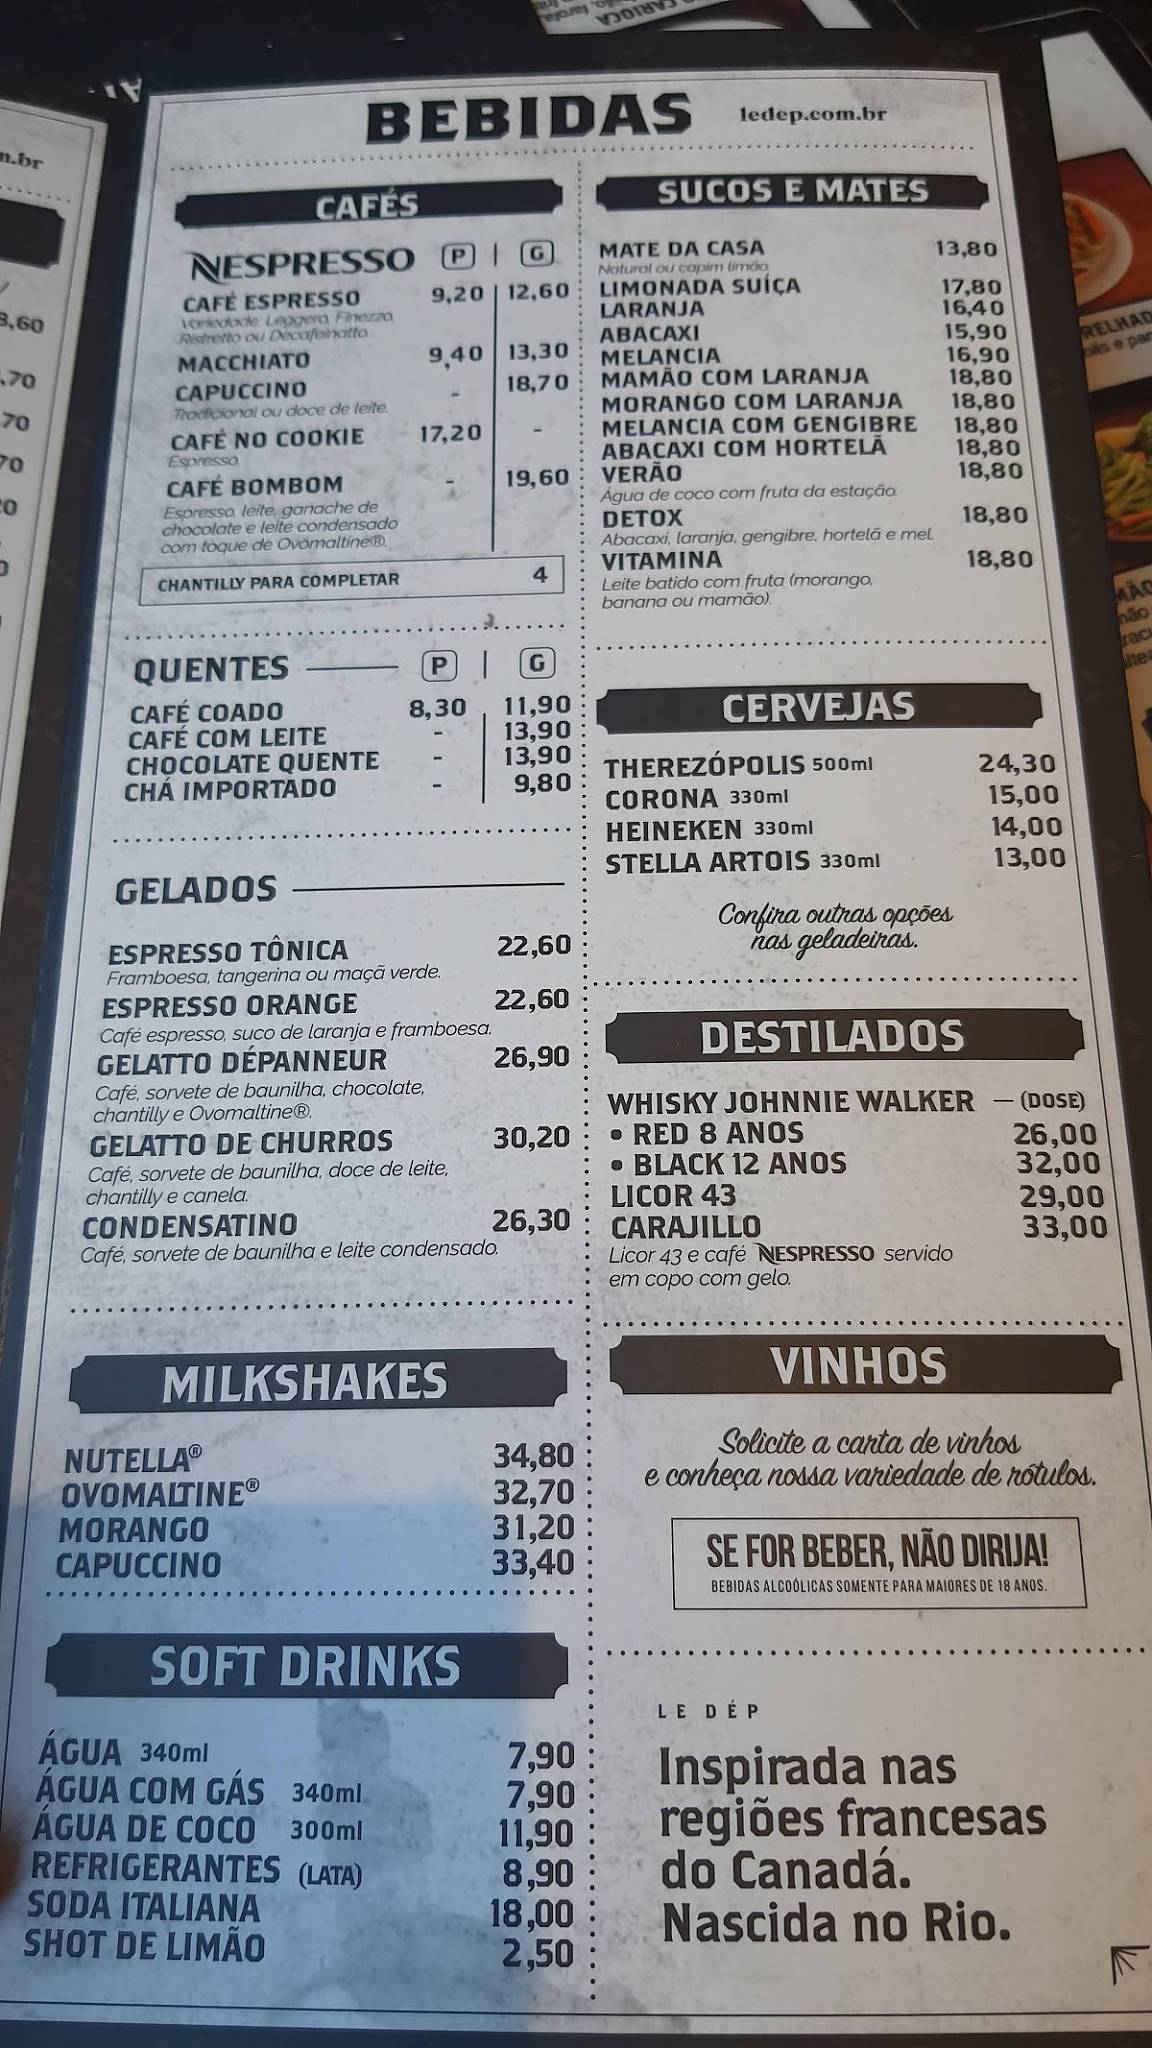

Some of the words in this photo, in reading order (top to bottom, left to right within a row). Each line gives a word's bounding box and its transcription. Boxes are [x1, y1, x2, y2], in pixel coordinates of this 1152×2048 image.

[366, 92, 692, 145] BEBIDAS
[740, 106, 887, 125] ledep.com.br
[317, 188, 418, 220] CAFÉS
[659, 179, 772, 204] SUCOS
[785, 179, 804, 201] E
[816, 179, 928, 202] MATES
[600, 242, 659, 258] MATE
[669, 242, 699, 256] DA
[708, 240, 764, 255] CASA
[937, 241, 997, 258] 13,80
[190, 248, 415, 285] NESPRESSO
[432, 286, 483, 304] 9,20
[509, 283, 569, 301] 12,60
[601, 279, 724, 297] LIMONADA
[733, 274, 800, 296] SUÍÇA
[943, 279, 1001, 296] 17,80
[184, 292, 236, 313] CAFÉ
[245, 290, 360, 310] ESPRESSO
[601, 301, 704, 318] LARANJA
[943, 299, 1004, 317] 16,40
[600, 325, 698, 343] ABACAXI
[946, 323, 1006, 342] 15,90
[178, 352, 310, 373] MACCHIATO
[429, 346, 482, 370] 9,40
[510, 343, 568, 361] 13,30
[602, 348, 720, 366] MELANCIA
[948, 347, 1009, 365] 16,90
[176, 381, 306, 402] CAPUCCINO
[508, 374, 568, 393] 18,70
[603, 418, 724, 437] MELANCIA
[733, 417, 783, 433] COM
[794, 416, 917, 432] GENGIBRE
[955, 417, 1017, 436] 18,80
[167, 475, 223, 498] CAFÉ
[232, 476, 342, 496] BOMBOM
[507, 469, 568, 489] 19,60
[603, 509, 682, 528] DETOX
[964, 506, 1028, 526] 18,80
[823, 528, 881, 541] hortelã
[886, 531, 896, 540] e
[158, 578, 245, 592] CHANTILLY
[251, 576, 294, 589] PARA
[300, 573, 399, 587] COMPLETAR
[533, 566, 548, 583] 4
[135, 656, 288, 686] QUENTES
[131, 699, 190, 724] CAFÉ
[198, 703, 283, 722] COADO
[410, 698, 466, 720] 8,30
[505, 695, 570, 717] 11,90
[723, 692, 914, 722] CERVEJAS
[604, 750, 805, 779] THEREZÓPOLIS
[813, 757, 872, 771] 500ml
[979, 754, 1055, 776] 24,30
[125, 777, 174, 802] CHÁ
[184, 778, 336, 801] IMPORTADO
[515, 773, 571, 796] 9,80
[989, 785, 1059, 807] 15,00
[606, 788, 718, 810] CORONA
[731, 789, 788, 804] 330ml
[116, 875, 276, 905] GELADOS
[719, 902, 801, 934] Confira
[806, 903, 877, 923] outras
[883, 905, 953, 929] opções
[109, 943, 241, 965] ESPRESSO
[251, 935, 348, 962] TÔNICA
[498, 935, 571, 959] 22,60
[751, 934, 792, 950] nas
[796, 926, 917, 960] geladeiras.
[107, 970, 209, 985] Framboesa,
[217, 967, 301, 986] tangerina
[306, 970, 328, 981] ou
[334, 965, 385, 983] maçã
[391, 964, 440, 979] verde.
[702, 1020, 964, 1054] DESTILADOS
[97, 1053, 211, 1076] GELATTO
[222, 1045, 386, 1073] DÉPANNEUR
[495, 1046, 569, 1071] 26,90
[607, 1092, 718, 1115] WHISKY
[724, 1091, 850, 1113] JOHNNIE
[856, 1090, 975, 1112] WALKER
[1021, 1091, 1085, 1112] (DOSE)
[612, 1184, 693, 1207] LICOR
[701, 1184, 736, 1206] 43
[1020, 1185, 1104, 1211] 29,00
[82, 1213, 297, 1239] CONDENSATINO
[493, 1209, 570, 1235] 26,30
[612, 1215, 760, 1239] CARAJILLO
[1023, 1215, 1107, 1242] 33,00
[81, 1246, 125, 1267] Café,
[132, 1246, 199, 1262] sorvete
[205, 1244, 228, 1260] de
[233, 1242, 315, 1260] baunilha
[321, 1246, 332, 1258] e
[338, 1241, 375, 1258] leite
[381, 1239, 498, 1257] condensado.
[770, 1347, 946, 1384] VINHOS
[163, 1362, 446, 1403] MILKSHAKES
[494, 1443, 573, 1472] 34,80
[494, 1479, 574, 1509] 32,70
[58, 1517, 209, 1543] MORANGO
[493, 1514, 574, 1544] 31,20
[707, 1534, 739, 1567] SE
[746, 1534, 795, 1567] FOR
[802, 1534, 894, 1572] BEBER,
[901, 1528, 954, 1567] NÃO
[961, 1533, 1048, 1567] DIRIJA!
[56, 1552, 221, 1579] CAPUCCINO
[492, 1549, 574, 1580] 33,40
[712, 1580, 759, 1592] BEBIDAS
[764, 1578, 833, 1592] ALCOÓLICAS
[837, 1580, 889, 1592] SOMENTE
[893, 1580, 923, 1592] PARA
[926, 1580, 976, 1592] MAIORES
[980, 1579, 993, 1592] DE
[999, 1579, 1010, 1592] 18
[1015, 1579, 1047, 1591] ANOS.
[151, 1646, 265, 1686] SOFT
[280, 1645, 459, 1686] DRINKS
[38, 1729, 121, 1766] ÁGUA
[141, 1743, 208, 1762] 340ml
[509, 1741, 574, 1774] 7,90
[660, 1746, 866, 1794] Inspirada
[881, 1755, 956, 1784] nas
[661, 1797, 824, 1846] regiões
[837, 1797, 1046, 1836] francesas
[31, 1851, 280, 1883] REFRIGERANTES
[299, 1862, 362, 1890] (LATA)
[504, 1859, 573, 1892] 8,90
[662, 1849, 715, 1889] do
[733, 1846, 910, 1889] Canadá.
[664, 1902, 837, 1942] Nascida
[853, 1912, 907, 1942] no
[924, 1901, 1010, 1941] Rio.
[24, 1928, 107, 1958] SHOT
[116, 1930, 157, 1960] DE
[167, 1926, 265, 1962] LIMÃO
[503, 1938, 573, 1973] 2,50
